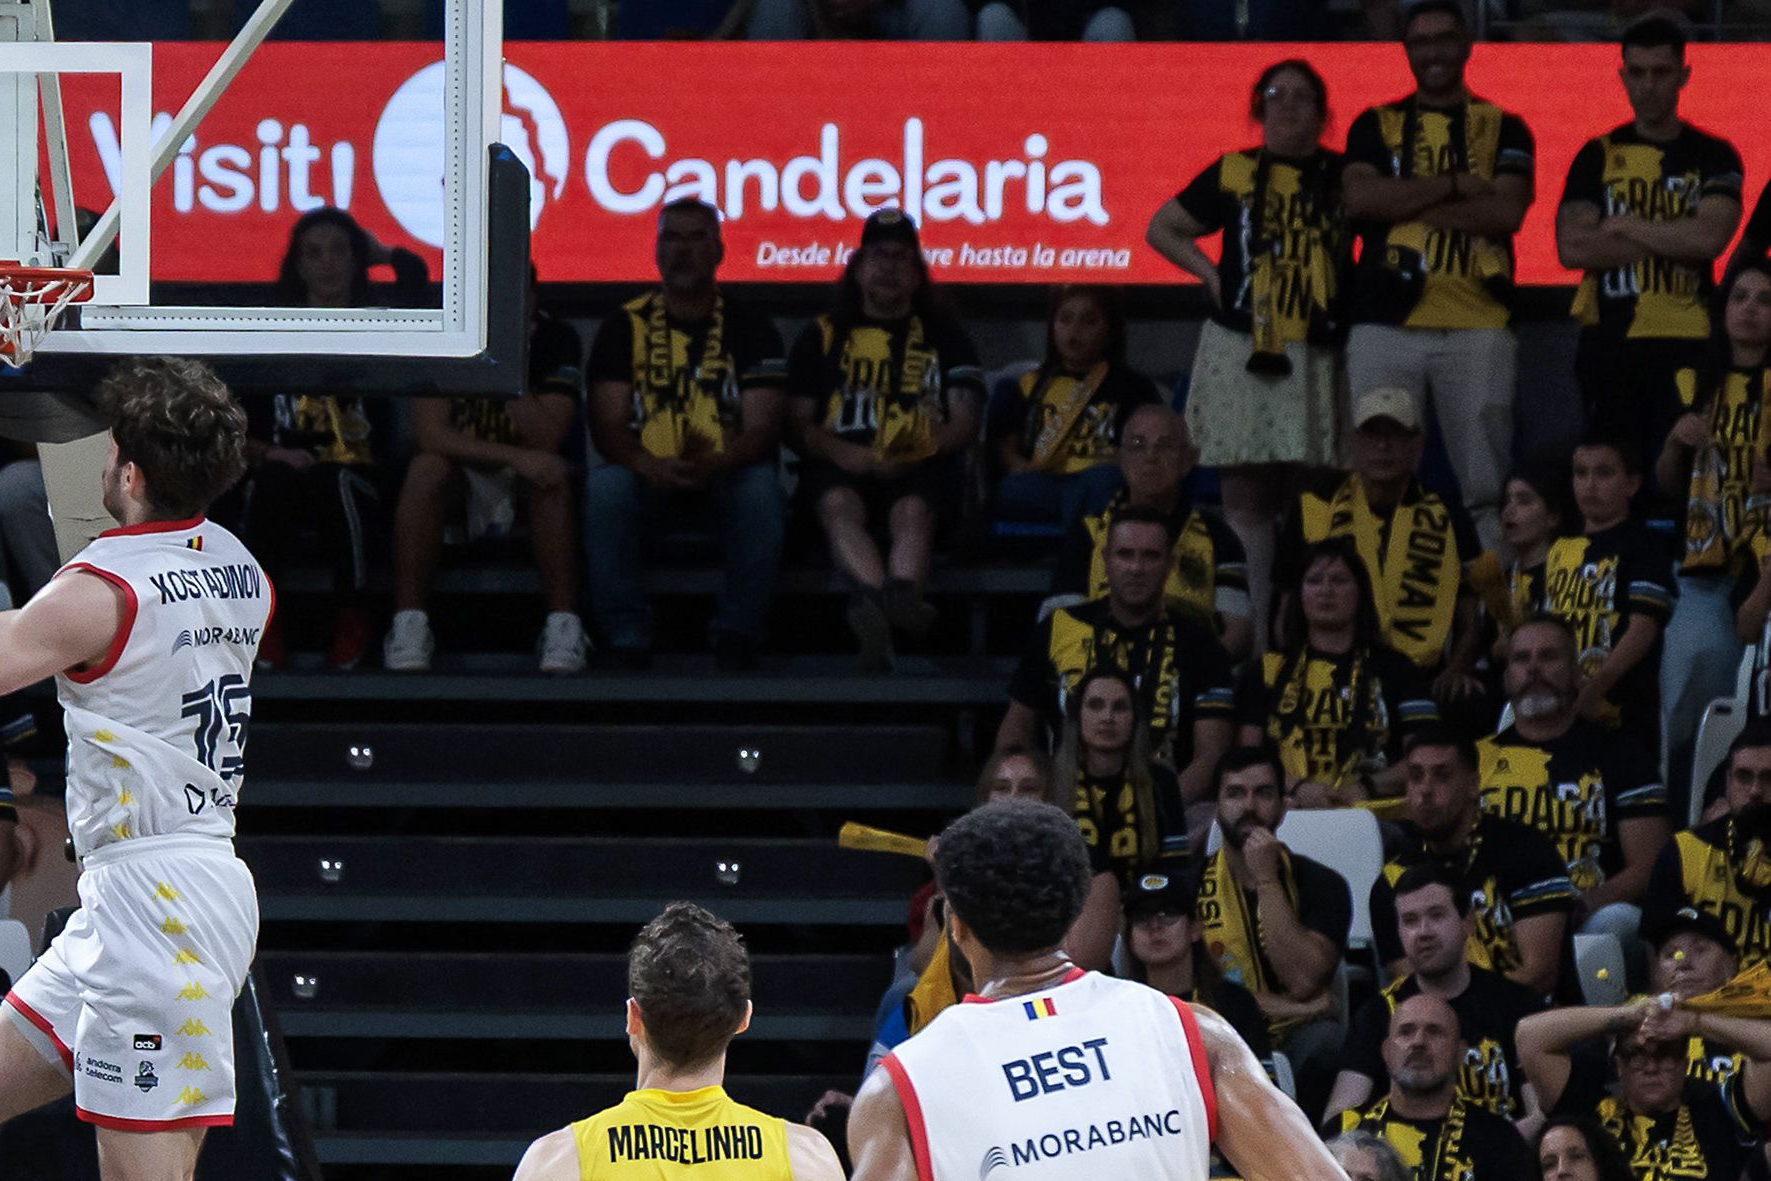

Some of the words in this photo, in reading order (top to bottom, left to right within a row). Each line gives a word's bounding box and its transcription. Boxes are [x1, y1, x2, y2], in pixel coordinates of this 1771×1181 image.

[585, 117, 1109, 226] Candelaria
[757, 241, 829, 266] Desde
[959, 241, 1027, 267] hasta
[1032, 242, 1055, 267] la
[1060, 247, 1131, 268] arena
[86, 1057, 122, 1073] andorra
[86, 1066, 124, 1084] telecom
[1002, 1037, 1111, 1102] BEST
[607, 1125, 764, 1164] MARCELINHO
[1011, 1110, 1181, 1167] MORABANC
